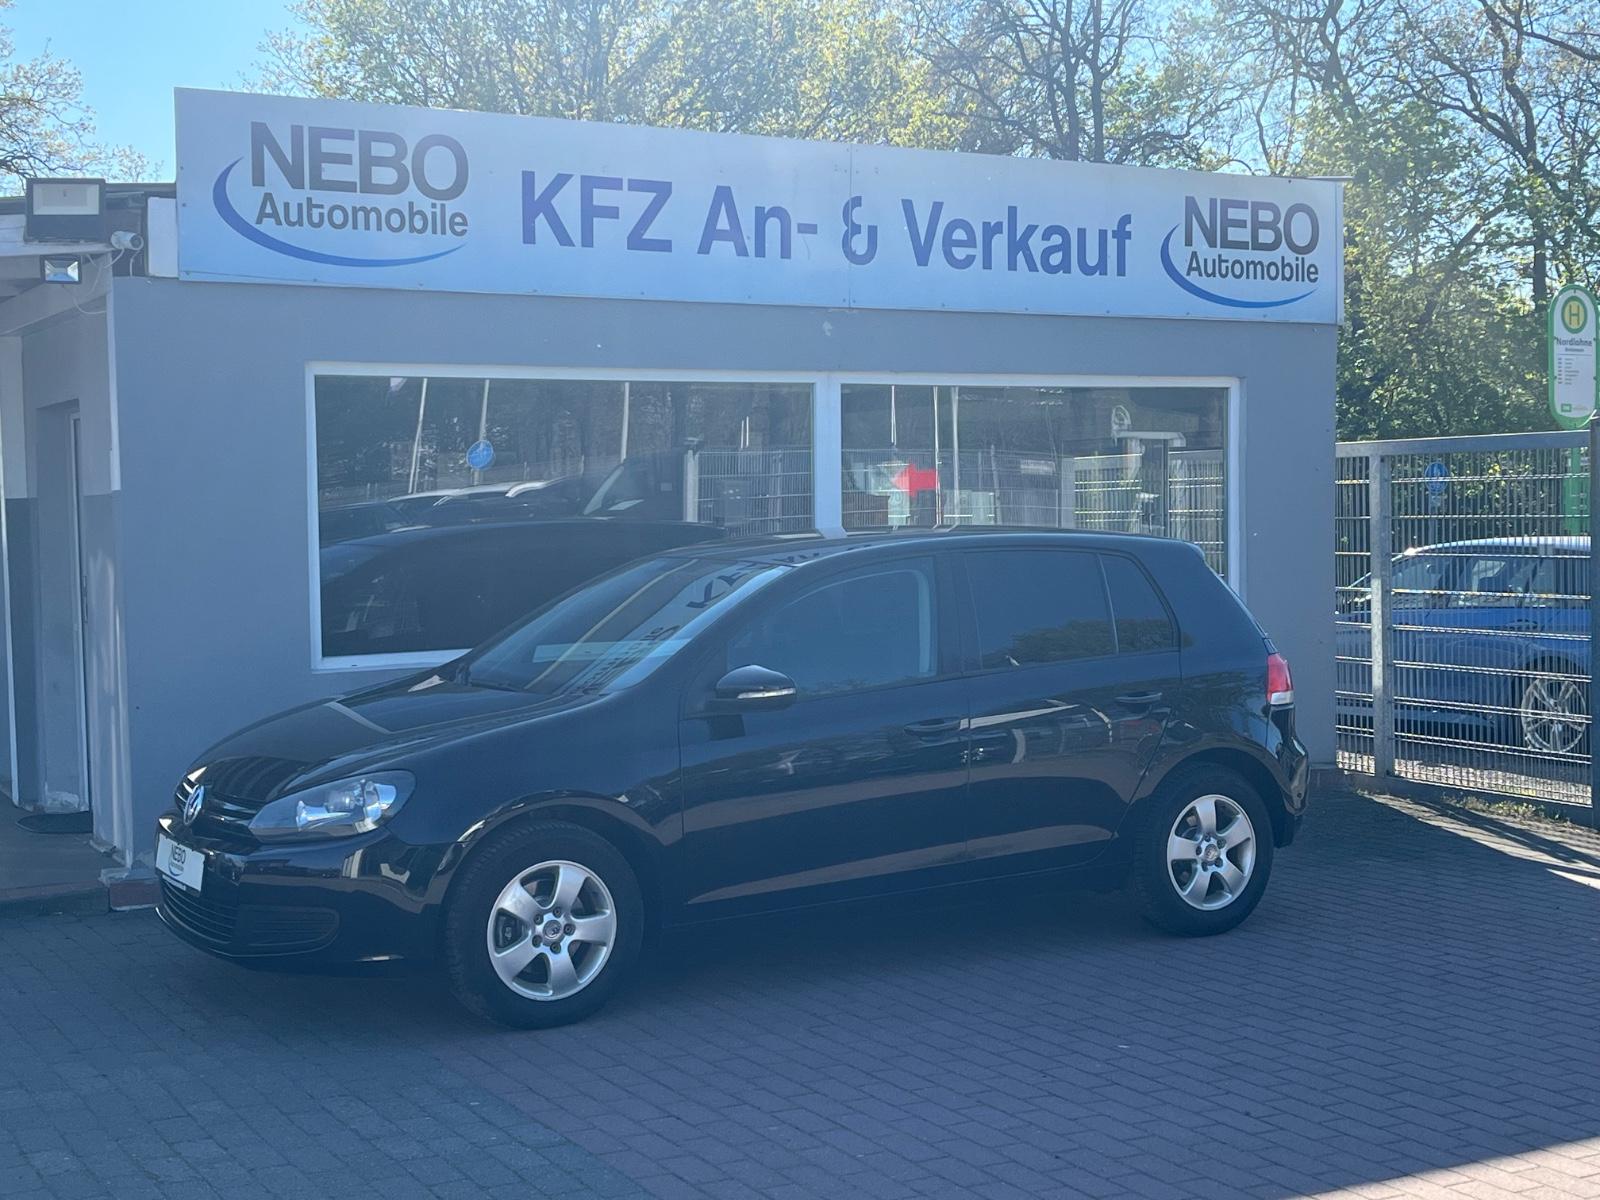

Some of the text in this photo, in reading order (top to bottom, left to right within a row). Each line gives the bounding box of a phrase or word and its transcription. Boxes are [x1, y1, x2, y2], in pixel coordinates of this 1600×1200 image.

[250, 121, 469, 201] NEBO
[255, 191, 469, 238] Automobile
[521, 170, 1132, 277] KFZ An- & Verkauf
[1184, 195, 1320, 256] NEBO
[1185, 250, 1319, 283] Automobile
[1569, 304, 1581, 326] H
